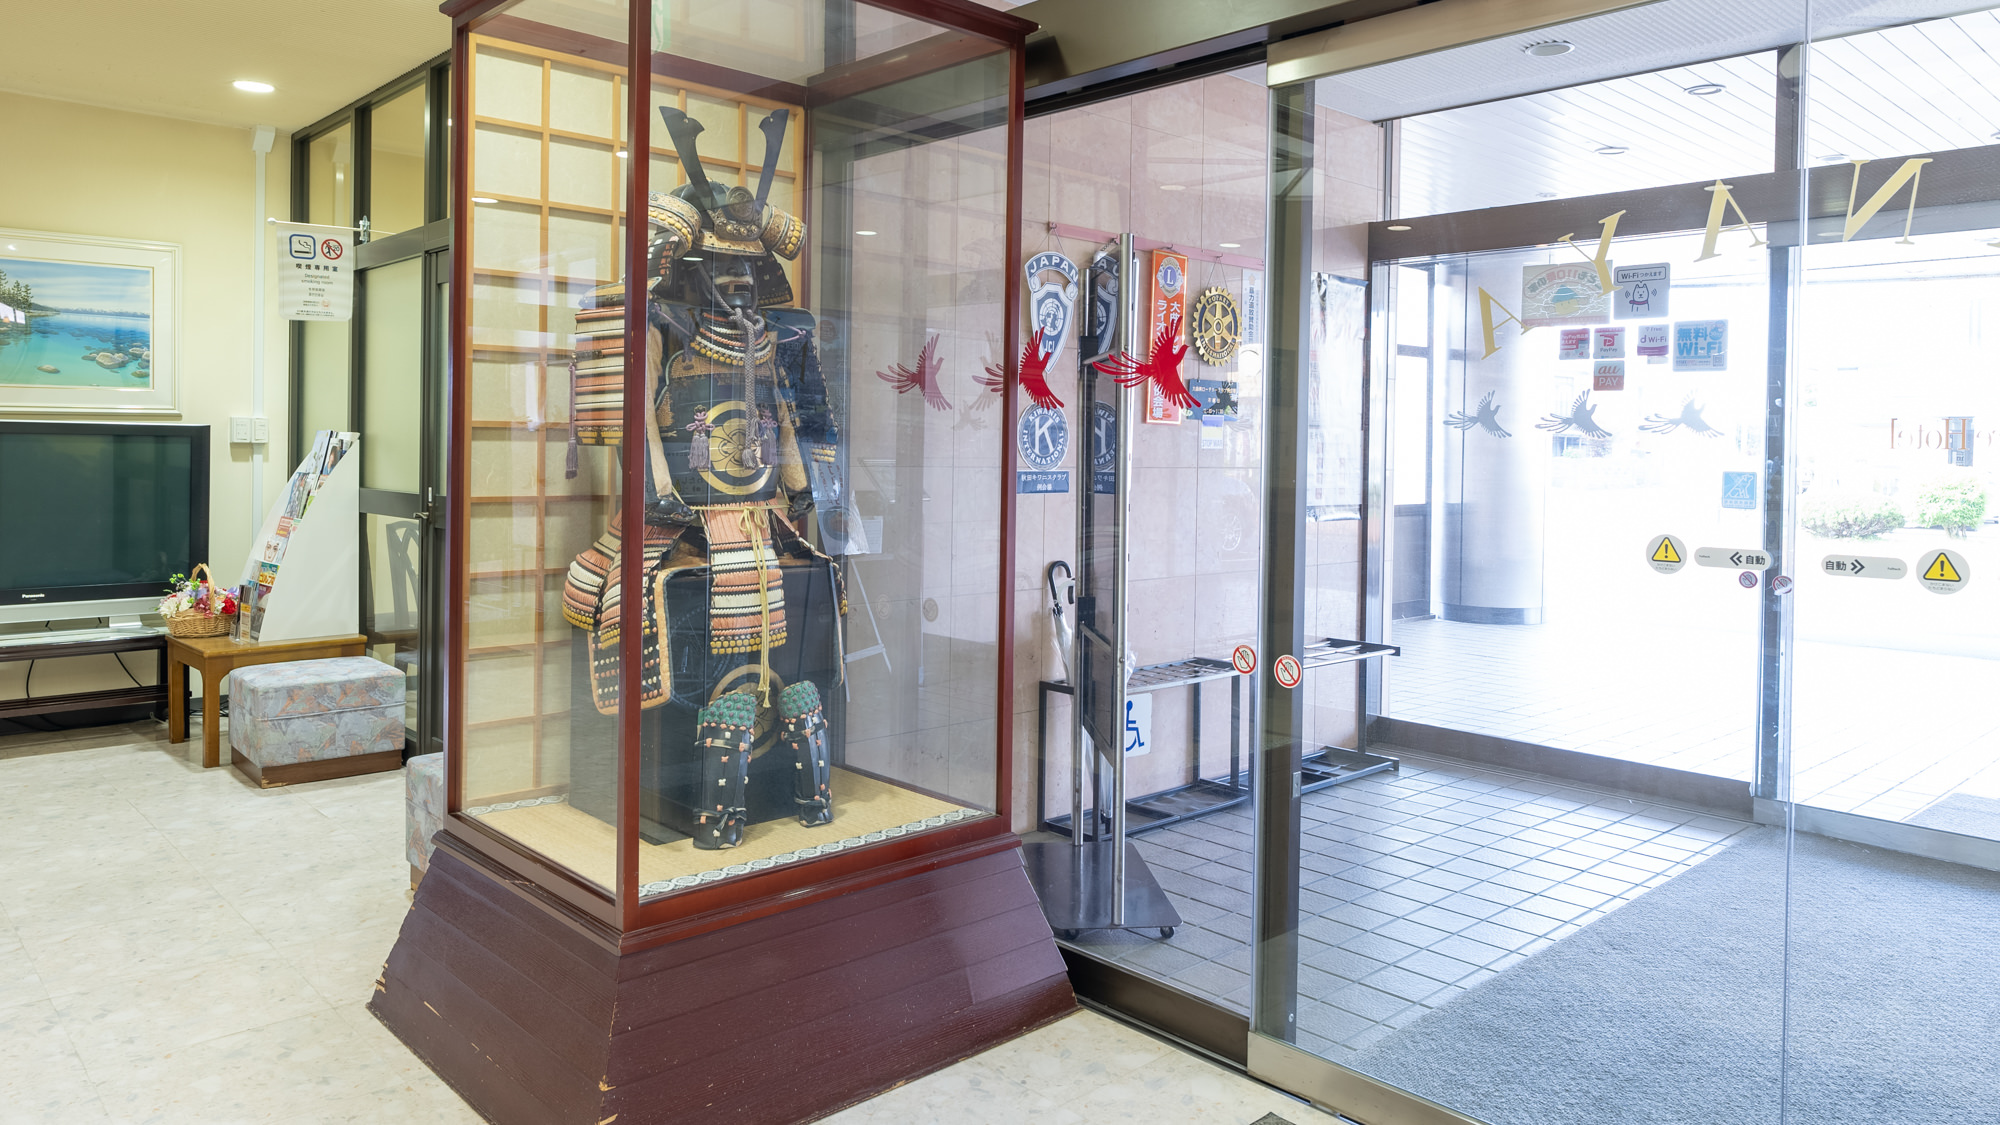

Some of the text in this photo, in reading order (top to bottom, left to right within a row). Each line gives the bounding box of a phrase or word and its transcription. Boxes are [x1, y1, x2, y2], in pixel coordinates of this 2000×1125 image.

[295, 263, 339, 272] 喫煙専用室
[1030, 255, 1078, 283] JAPAN
[1207, 294, 1231, 306] ROTARY
[1677, 326, 1708, 342] 無料
[1677, 341, 1723, 356] Wi-Fi
[1598, 365, 1621, 375] au
[1599, 377, 1619, 387] PAY
[1028, 407, 1061, 424] KIWANIS
[1034, 417, 1055, 455] K
[1022, 429, 1065, 465] INTERNATIONAL
[1021, 473, 1067, 482] 秋田キワニスクラブ
[1745, 555, 1766, 566] 自動
[1825, 560, 1847, 571] 自動
